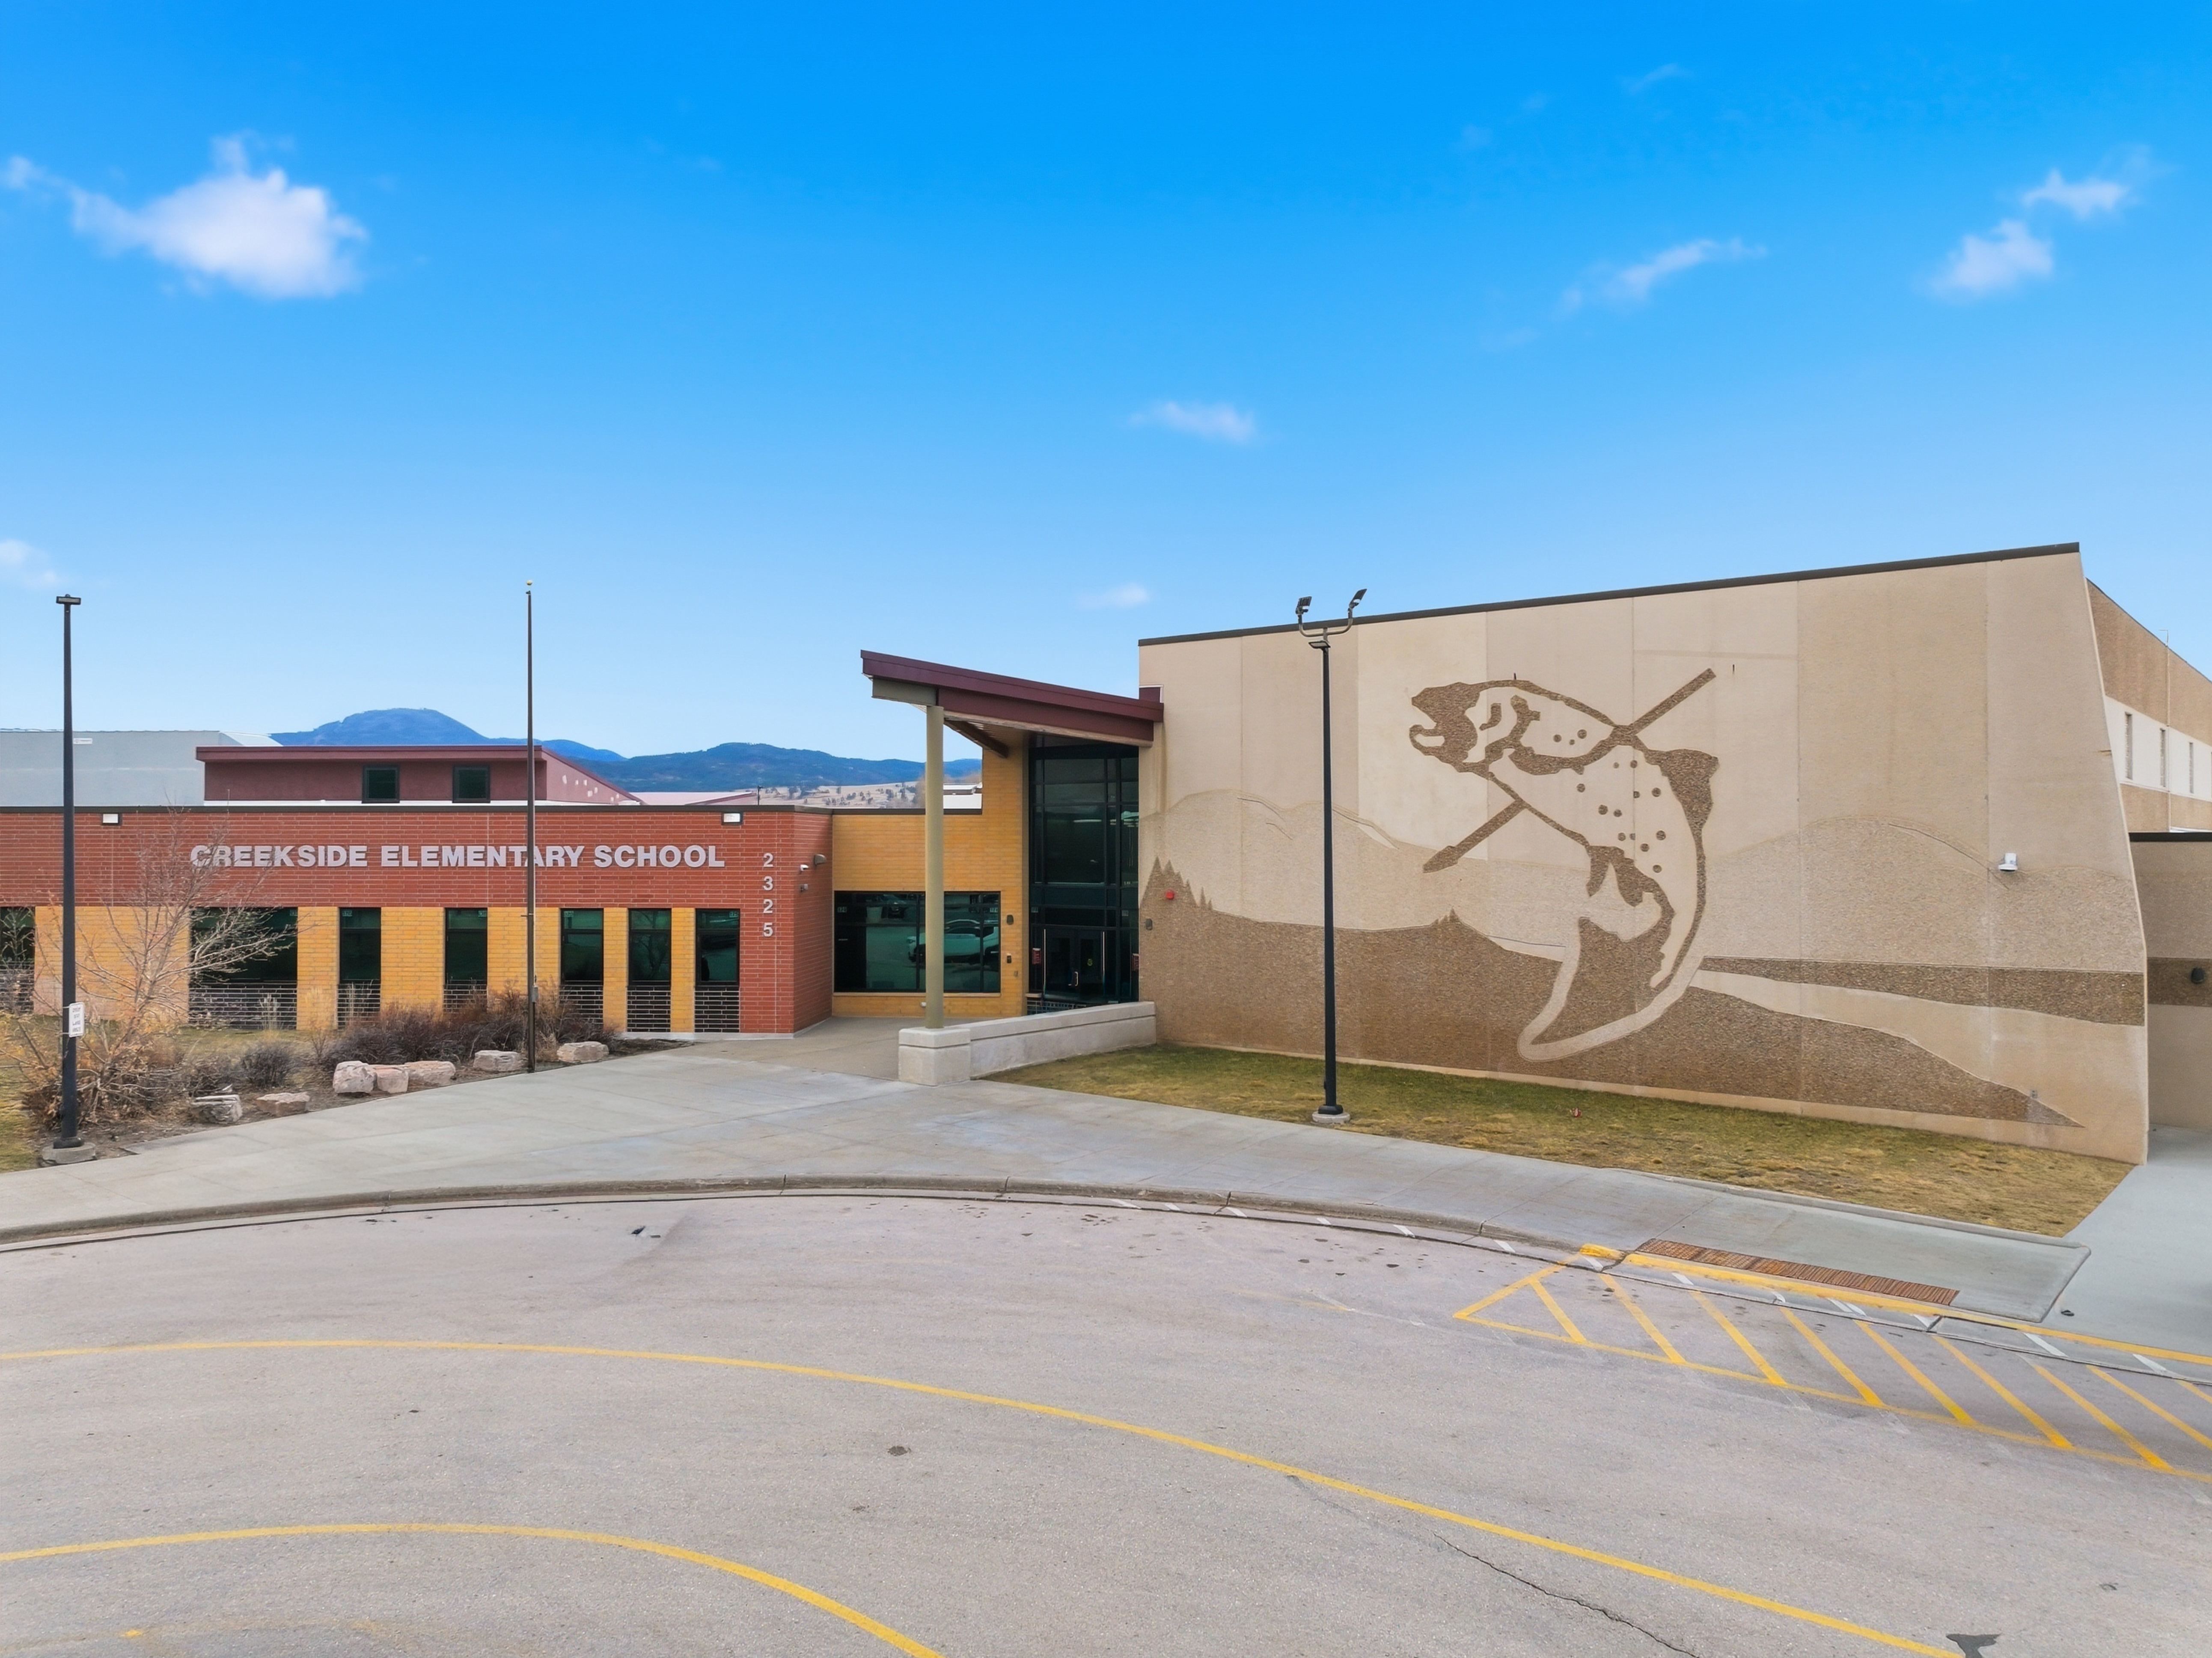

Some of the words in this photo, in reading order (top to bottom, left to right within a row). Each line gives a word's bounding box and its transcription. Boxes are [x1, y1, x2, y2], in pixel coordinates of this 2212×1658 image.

[190, 845, 368, 867] CREEKSIDE
[381, 845, 585, 867] ELEMENTARY
[594, 845, 725, 868] SCHOOL
